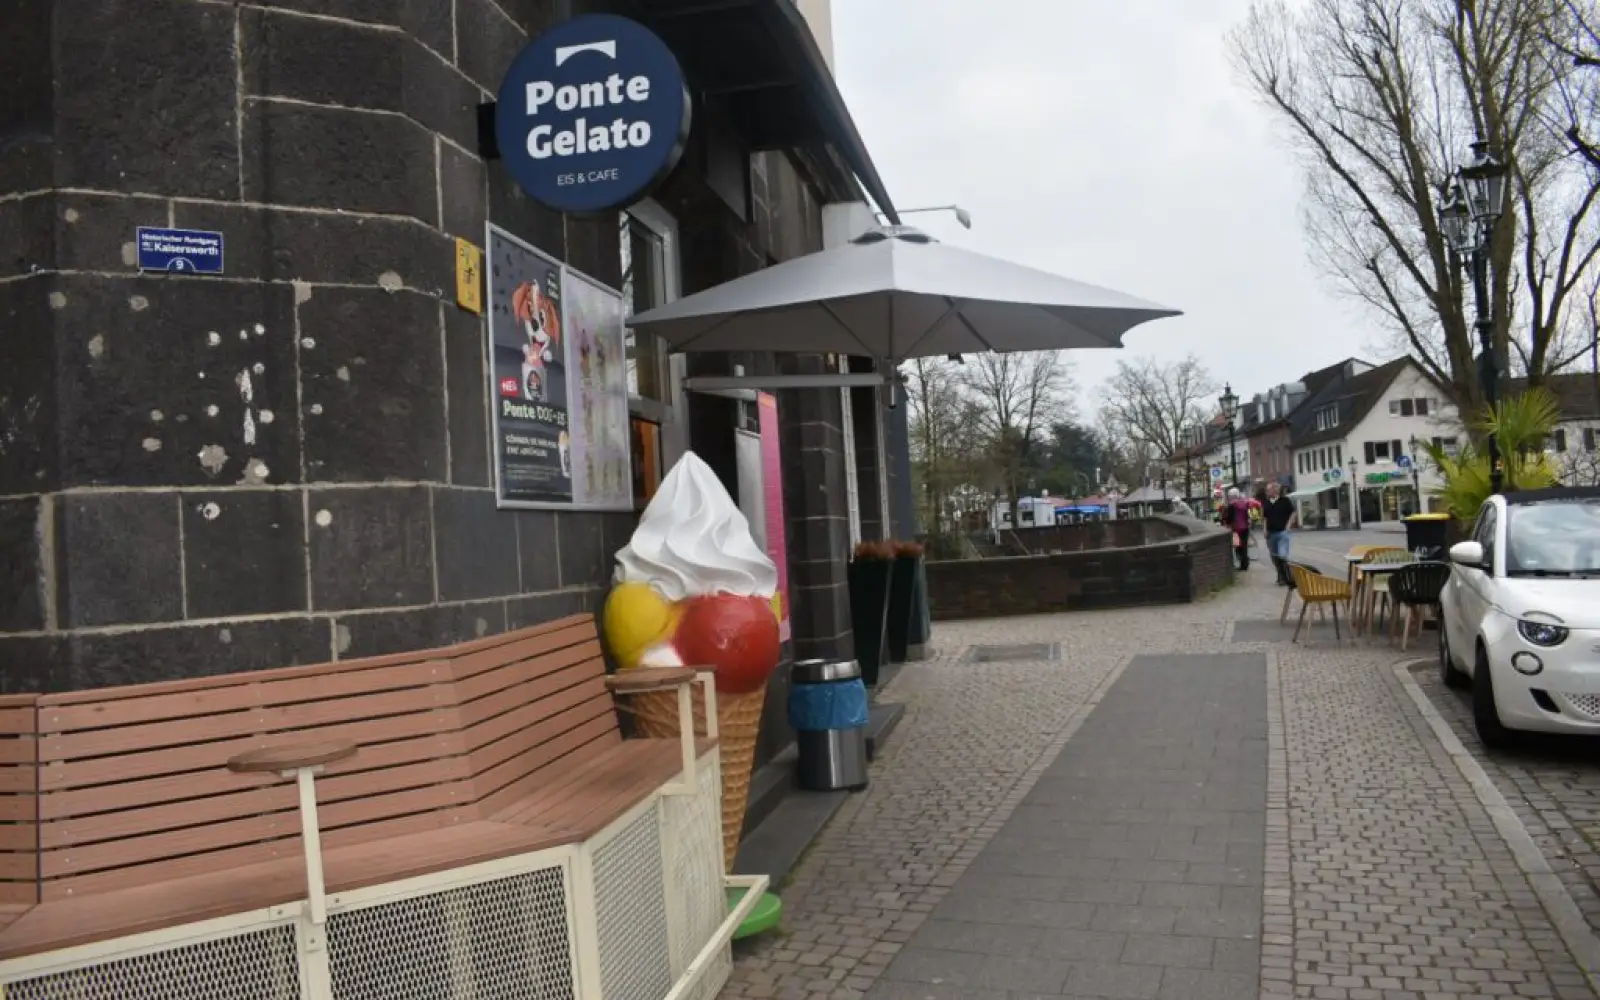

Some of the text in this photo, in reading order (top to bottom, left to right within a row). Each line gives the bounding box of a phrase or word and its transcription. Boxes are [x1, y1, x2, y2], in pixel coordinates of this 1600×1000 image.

[525, 73, 650, 115] Ponte
[526, 117, 651, 160] Gelato
[557, 168, 619, 186] EIS & CAFE
[154, 242, 219, 255] Kaiserswerth
[175, 260, 184, 270] 9
[503, 399, 536, 419] Ponte
